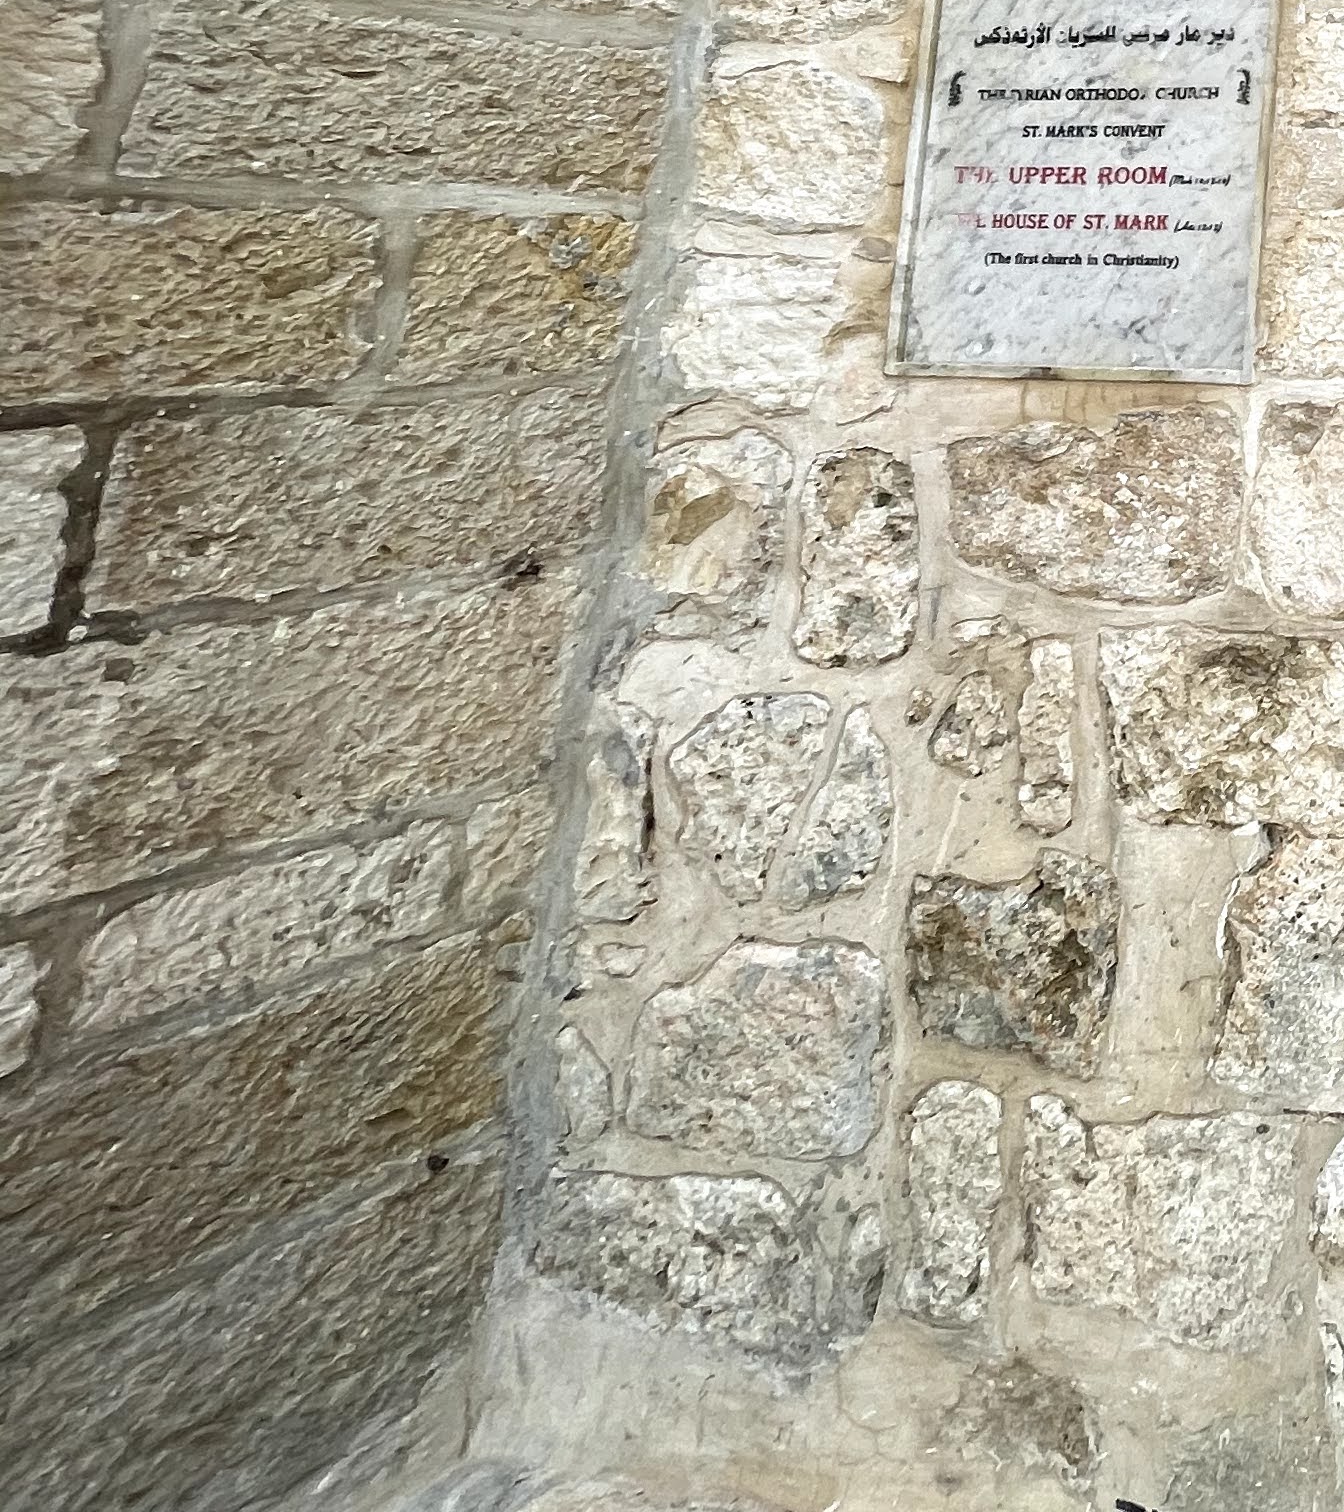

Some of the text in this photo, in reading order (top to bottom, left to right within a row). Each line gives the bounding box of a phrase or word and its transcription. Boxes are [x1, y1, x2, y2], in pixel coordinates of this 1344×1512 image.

[1021, 125, 1043, 138] ST.
[1103, 124, 1166, 138] CONVENT
[1008, 166, 1088, 185] UPPER
[1097, 166, 1168, 185] ROOM
[991, 213, 1049, 229] HOUSE
[1053, 213, 1077, 229] OF
[1113, 213, 1169, 230] MARK
[984, 252, 1180, 269] (The first church in Christianity)
